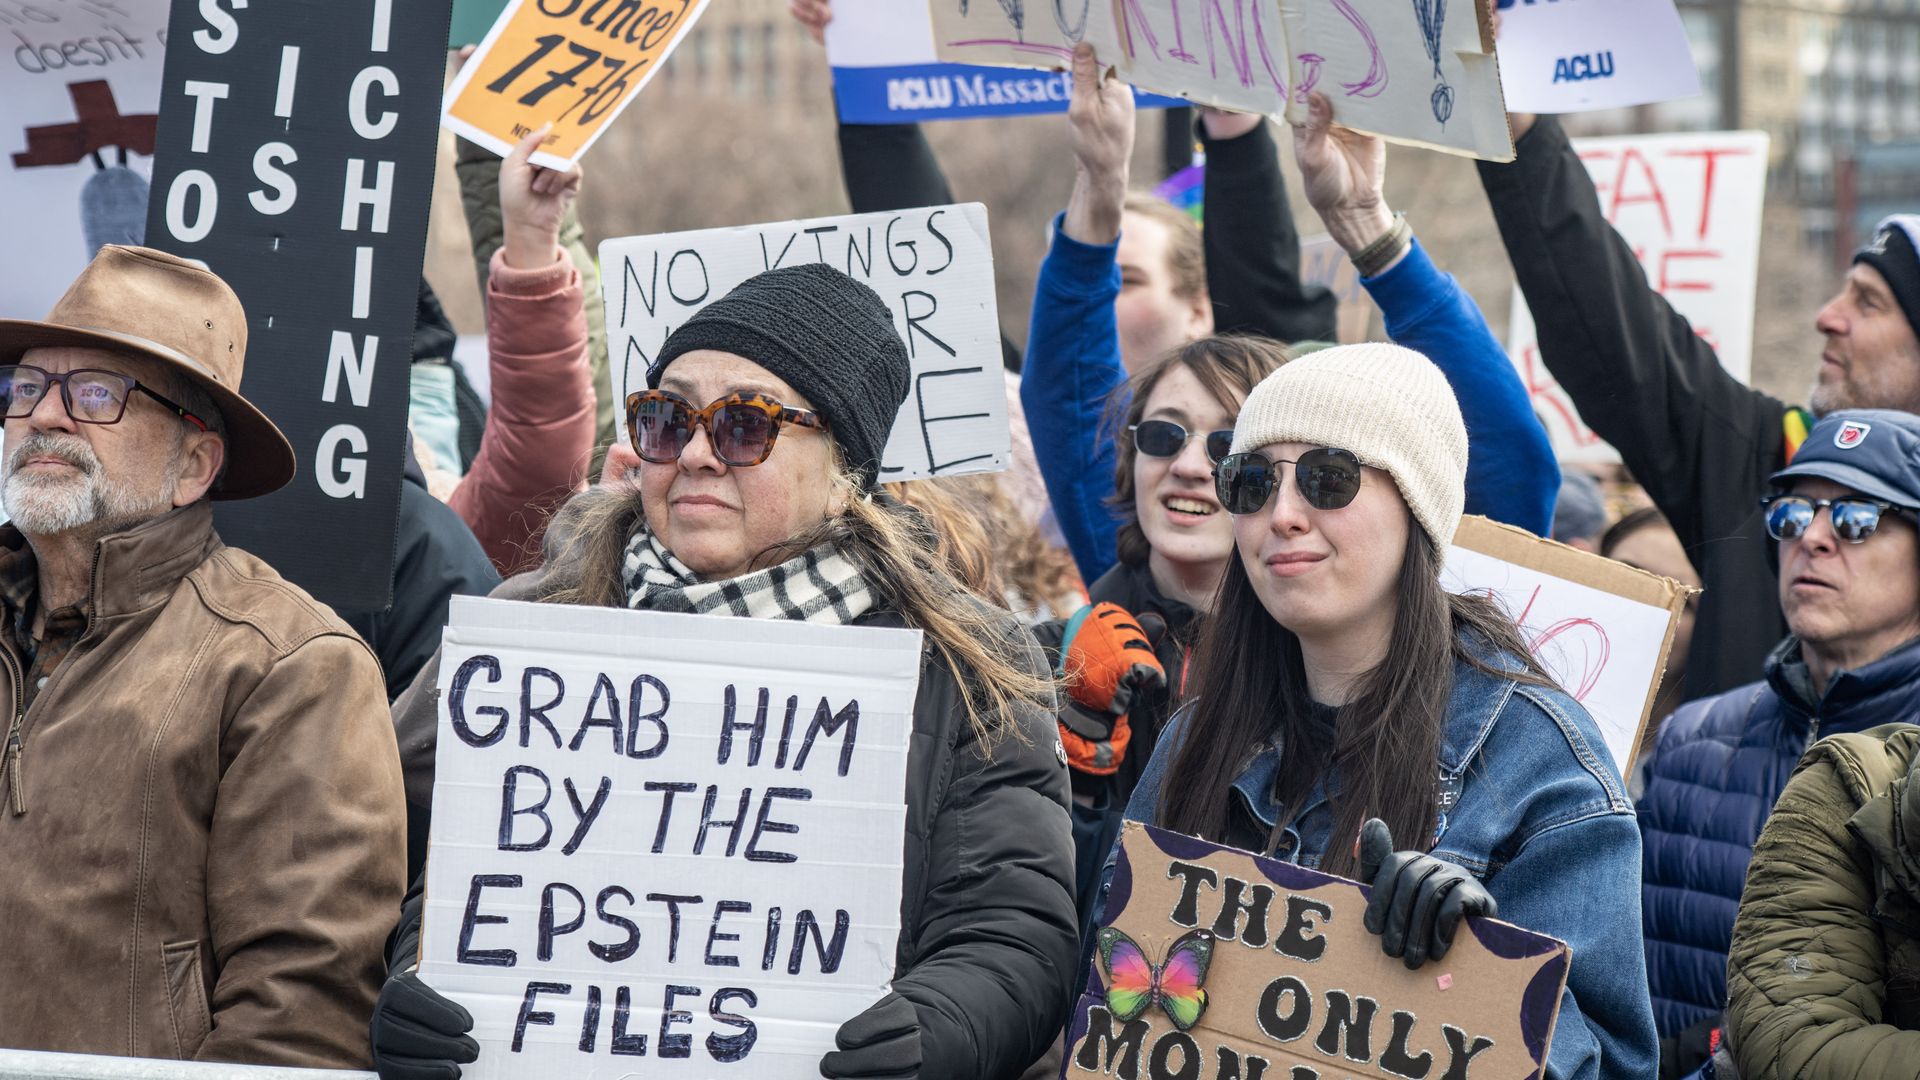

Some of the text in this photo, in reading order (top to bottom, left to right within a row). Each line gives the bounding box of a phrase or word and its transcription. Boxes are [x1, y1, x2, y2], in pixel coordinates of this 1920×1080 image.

[486, 34, 649, 126] 1776
[886, 75, 953, 111] ACLU
[1552, 51, 1615, 84] ACLU
[165, 0, 249, 271] STO
[247, 45, 300, 215] IS
[620, 249, 710, 328] NO
[447, 654, 861, 778] GRAB HIM
[497, 764, 813, 863] BY THE
[456, 873, 850, 974] EPSTEIN
[1166, 858, 1334, 963] THE
[511, 981, 759, 1064] FILES
[1256, 974, 1495, 1080] ONLY
